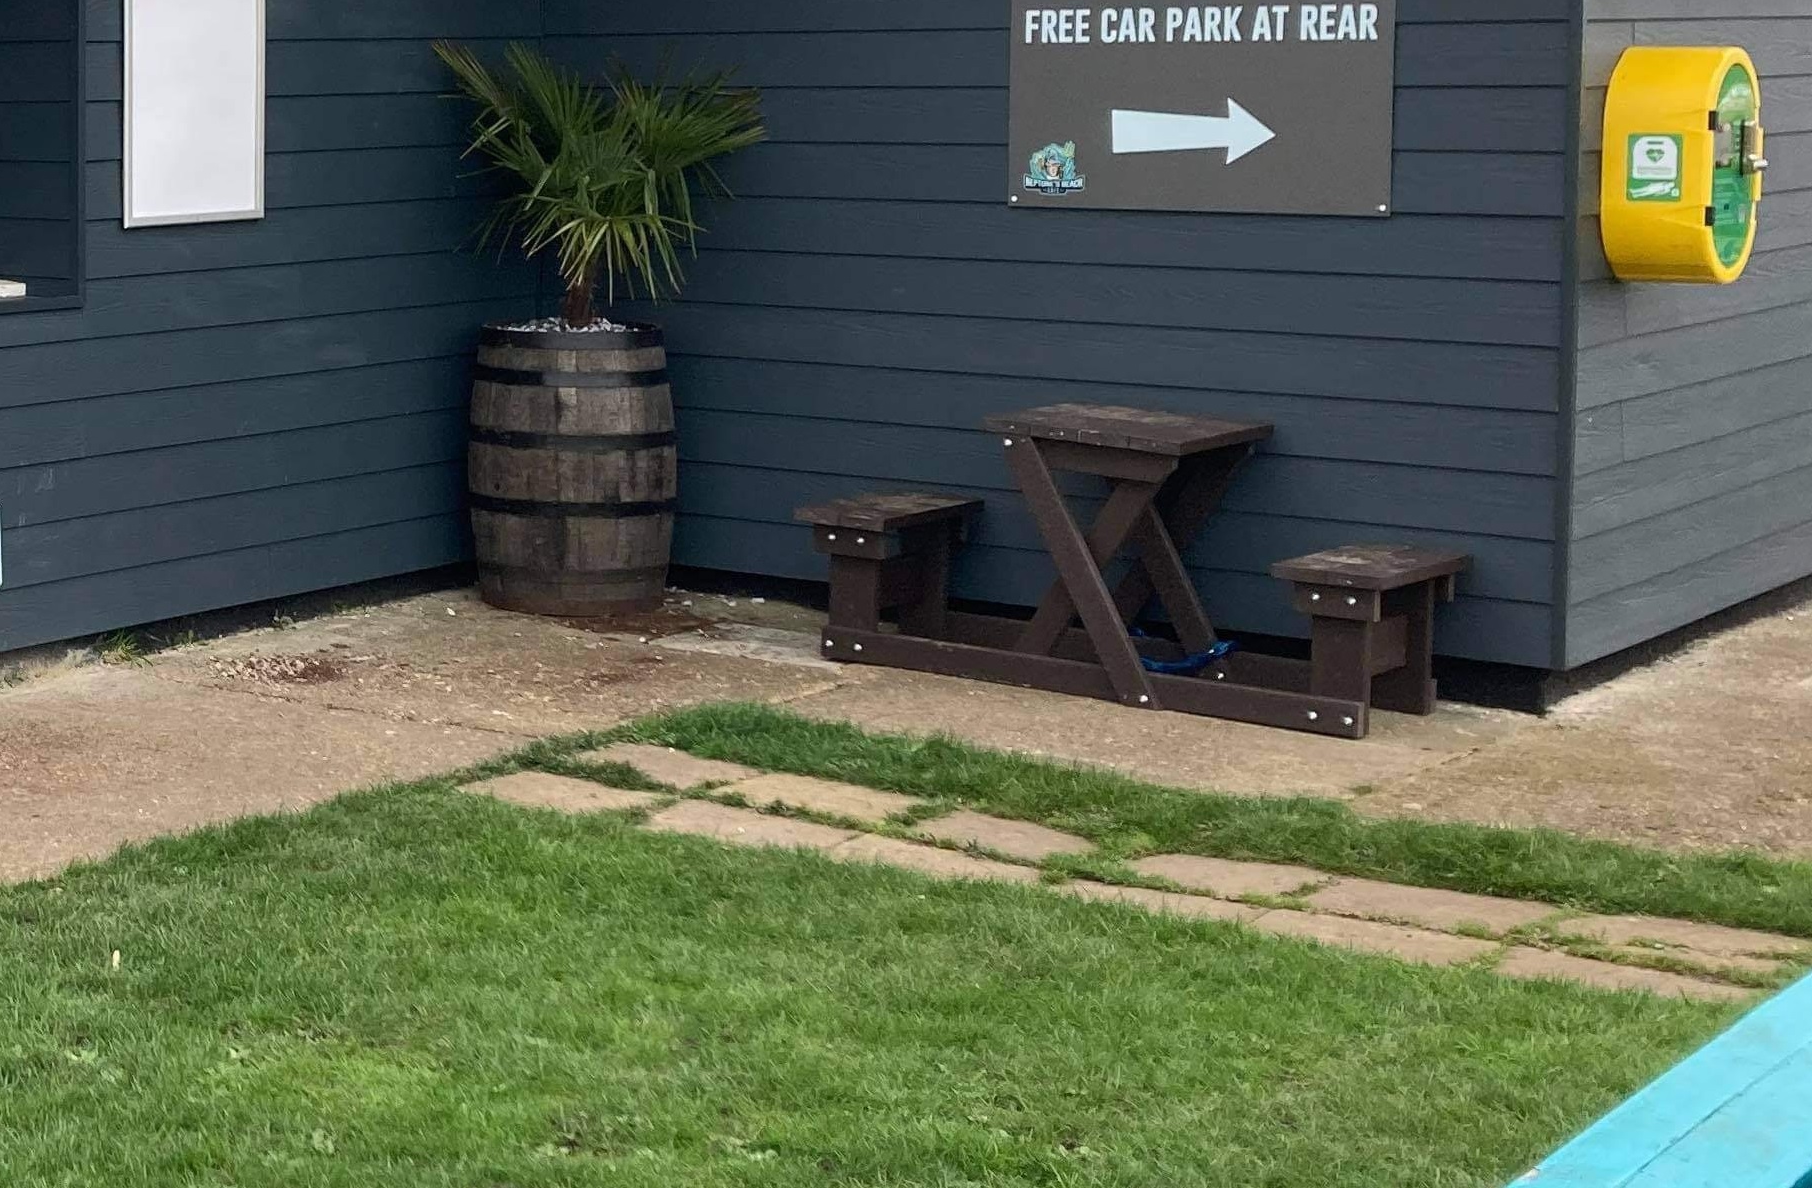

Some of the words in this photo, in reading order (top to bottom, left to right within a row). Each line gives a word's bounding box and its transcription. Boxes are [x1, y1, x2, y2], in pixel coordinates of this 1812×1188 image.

[1025, 8, 1090, 43] FREE
[1100, 7, 1156, 43] CAR
[1166, 5, 1243, 42] PARK
[1252, 6, 1289, 41] AT
[1299, 3, 1379, 41] REAR
